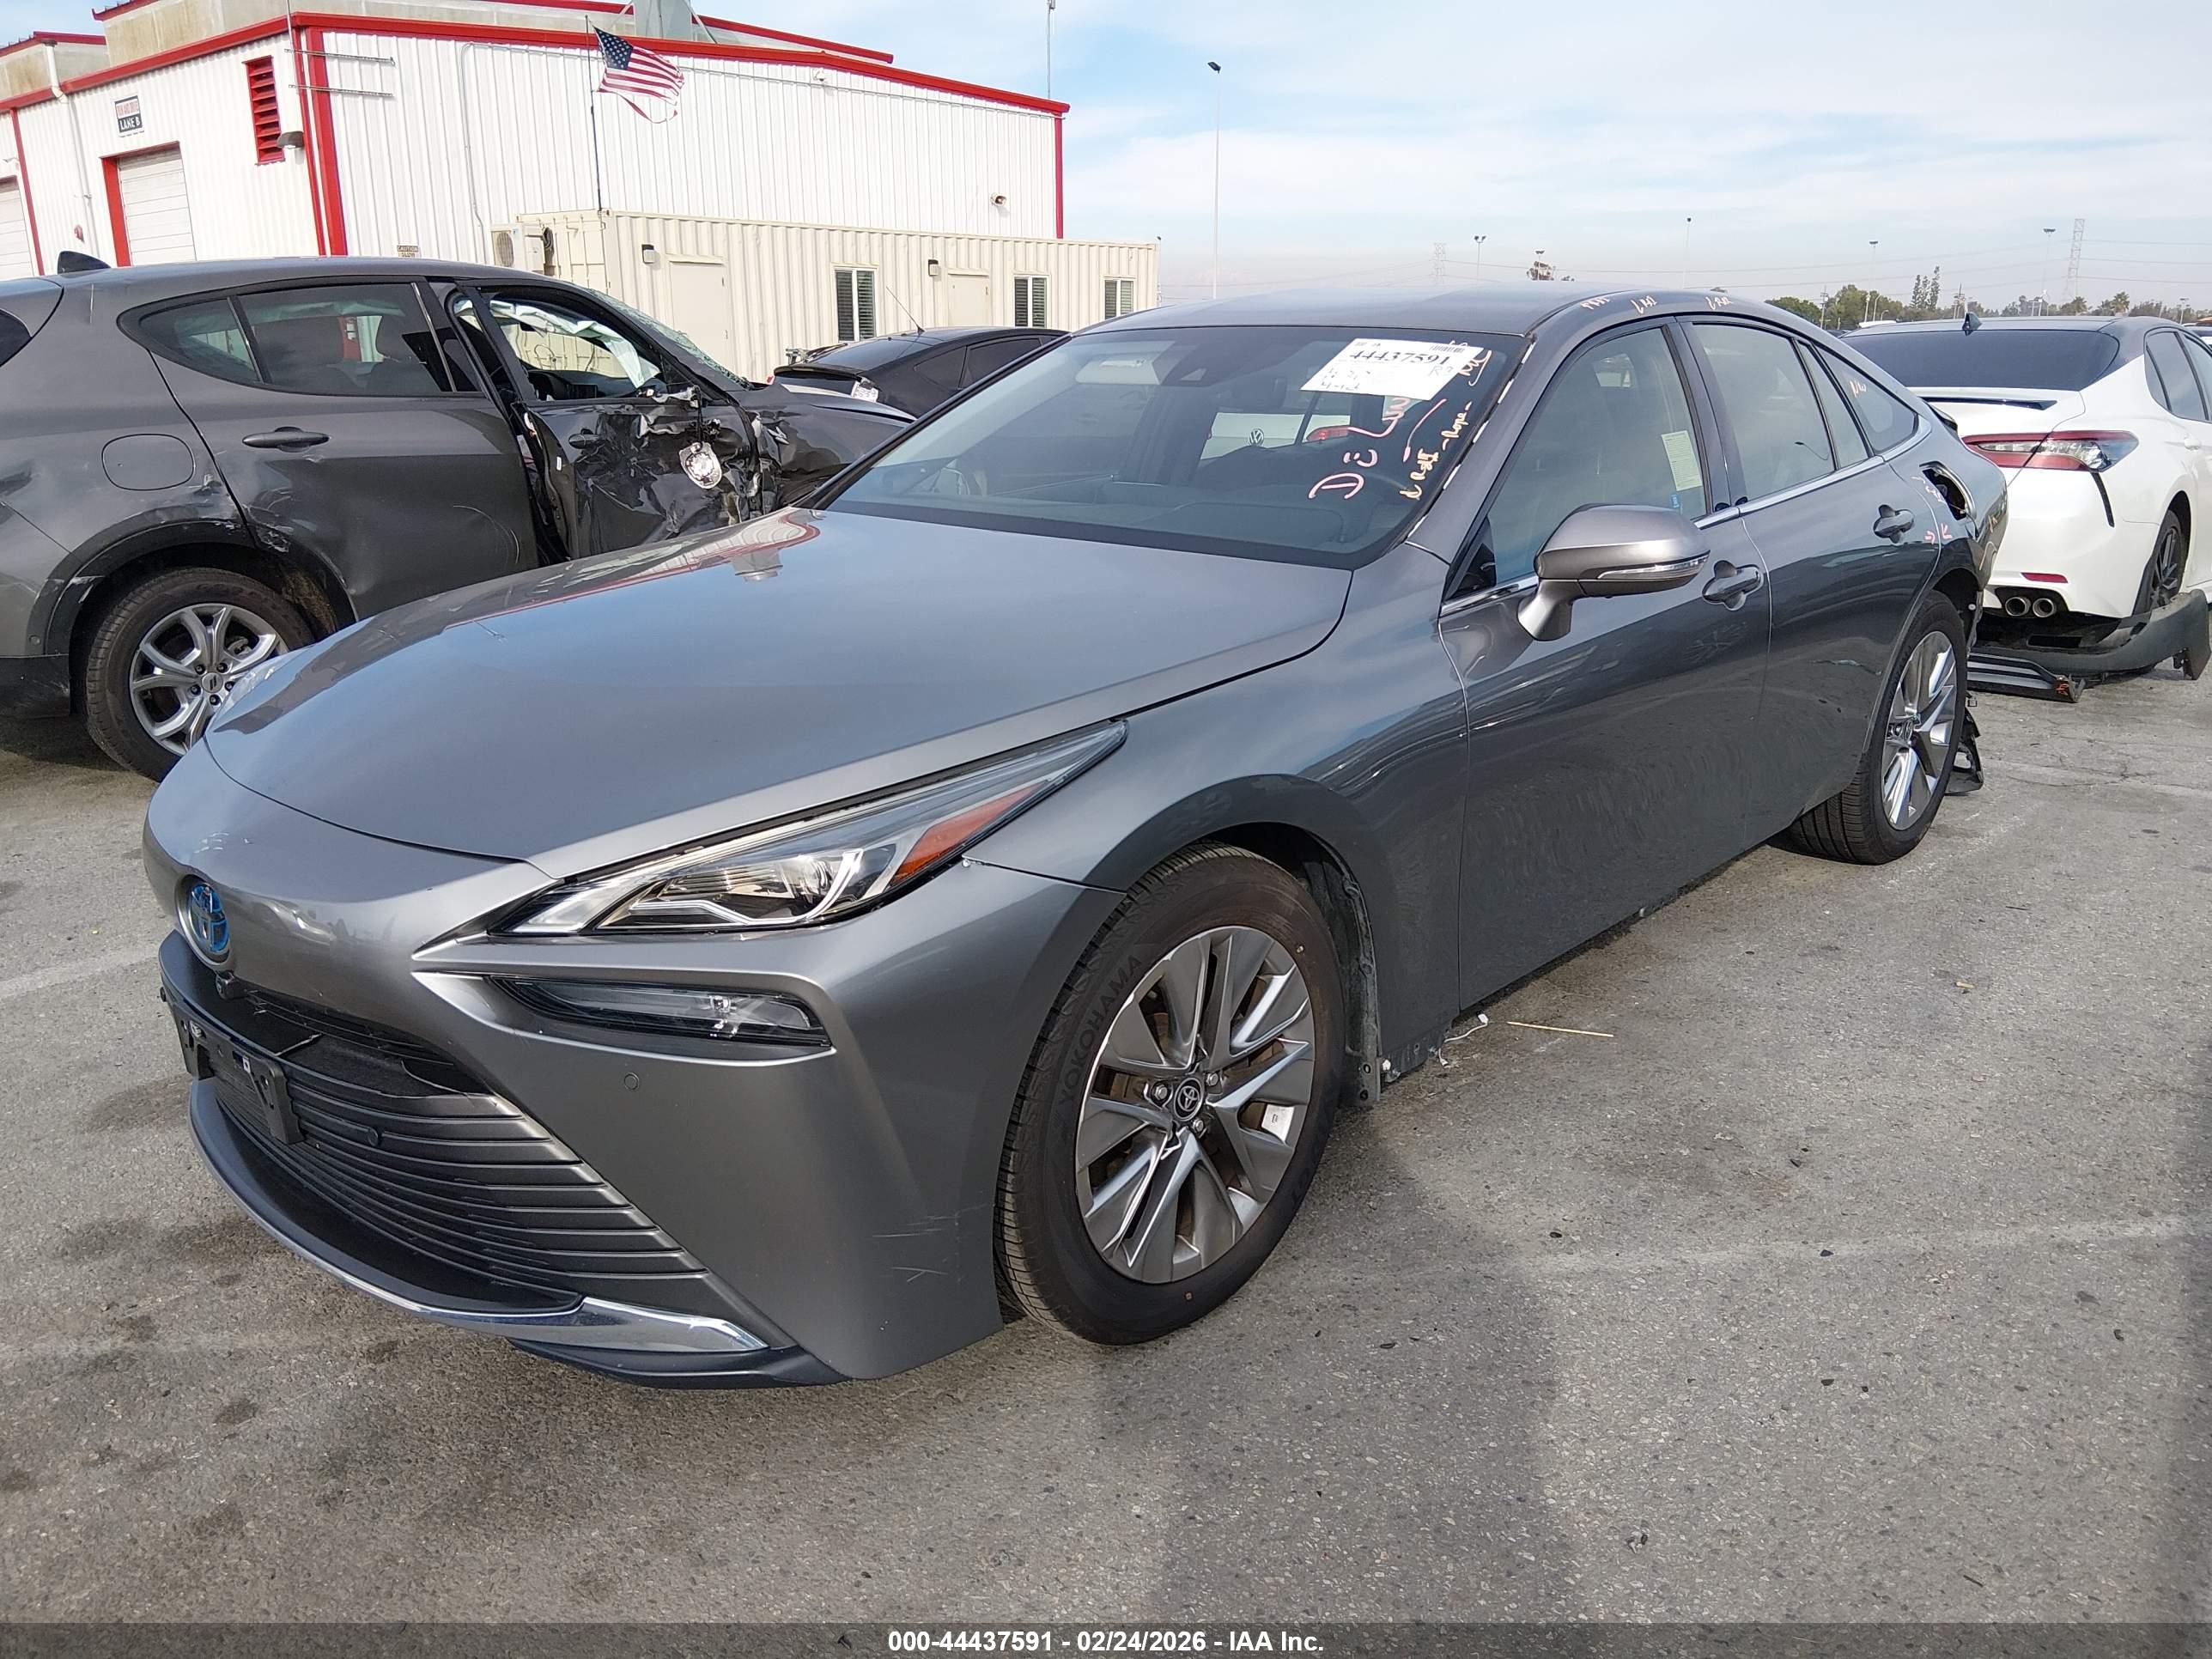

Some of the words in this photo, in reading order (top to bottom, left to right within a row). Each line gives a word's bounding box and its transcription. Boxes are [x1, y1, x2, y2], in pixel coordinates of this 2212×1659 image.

[119, 118, 135, 130] LANE
[136, 116, 141, 127] B
[1349, 349, 1451, 365] 44437591
[1059, 954, 1142, 1105] YOKOHAMA
